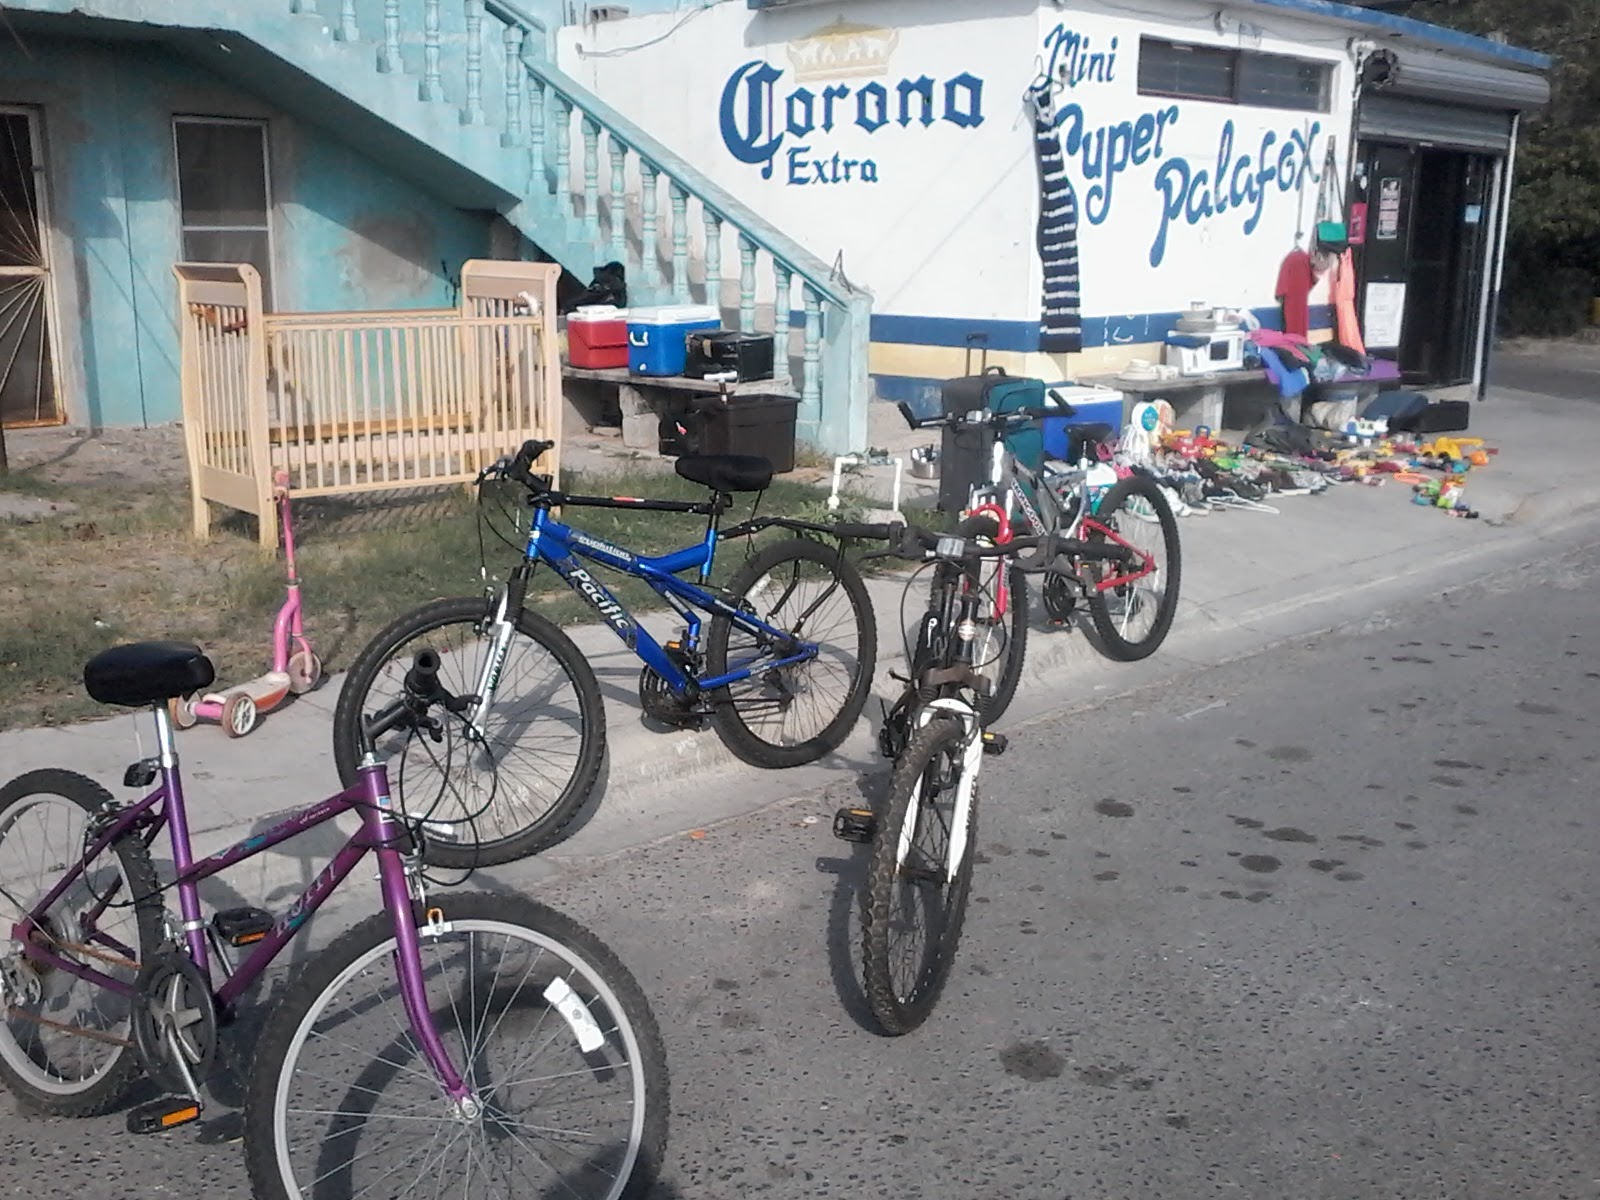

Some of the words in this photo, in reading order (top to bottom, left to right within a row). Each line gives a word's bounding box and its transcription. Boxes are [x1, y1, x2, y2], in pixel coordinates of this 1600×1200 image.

[1044, 22, 1118, 87] Mini
[719, 60, 985, 180] Corona
[786, 146, 878, 186] Extra
[569, 568, 629, 630] Pacific
